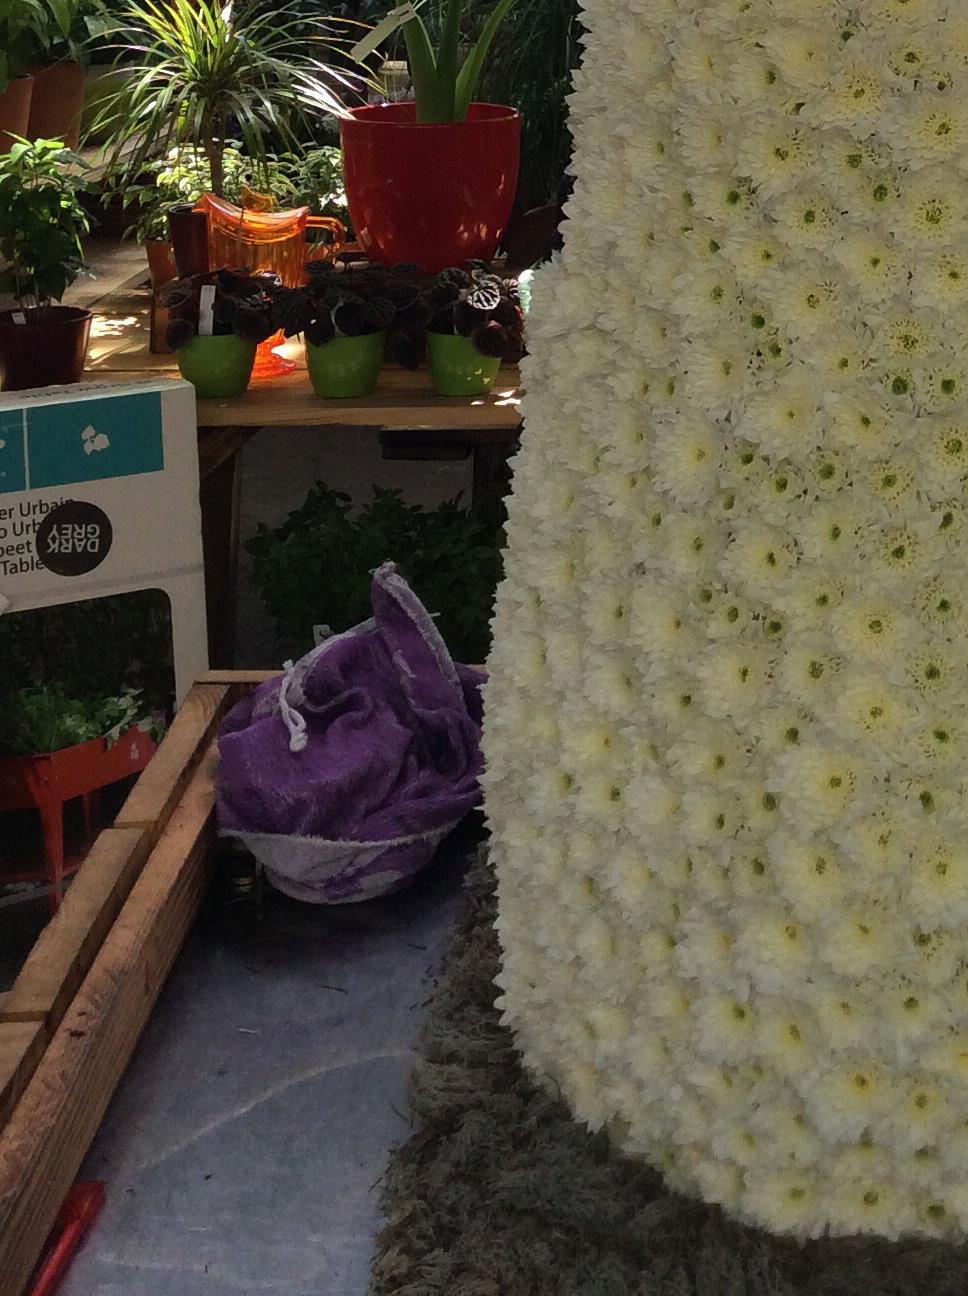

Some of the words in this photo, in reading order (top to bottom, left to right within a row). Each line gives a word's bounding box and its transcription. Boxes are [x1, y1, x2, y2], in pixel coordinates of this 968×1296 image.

[47, 524, 100, 539] GREY
[46, 538, 100, 553] DARK
[0, 556, 45, 576] Table
